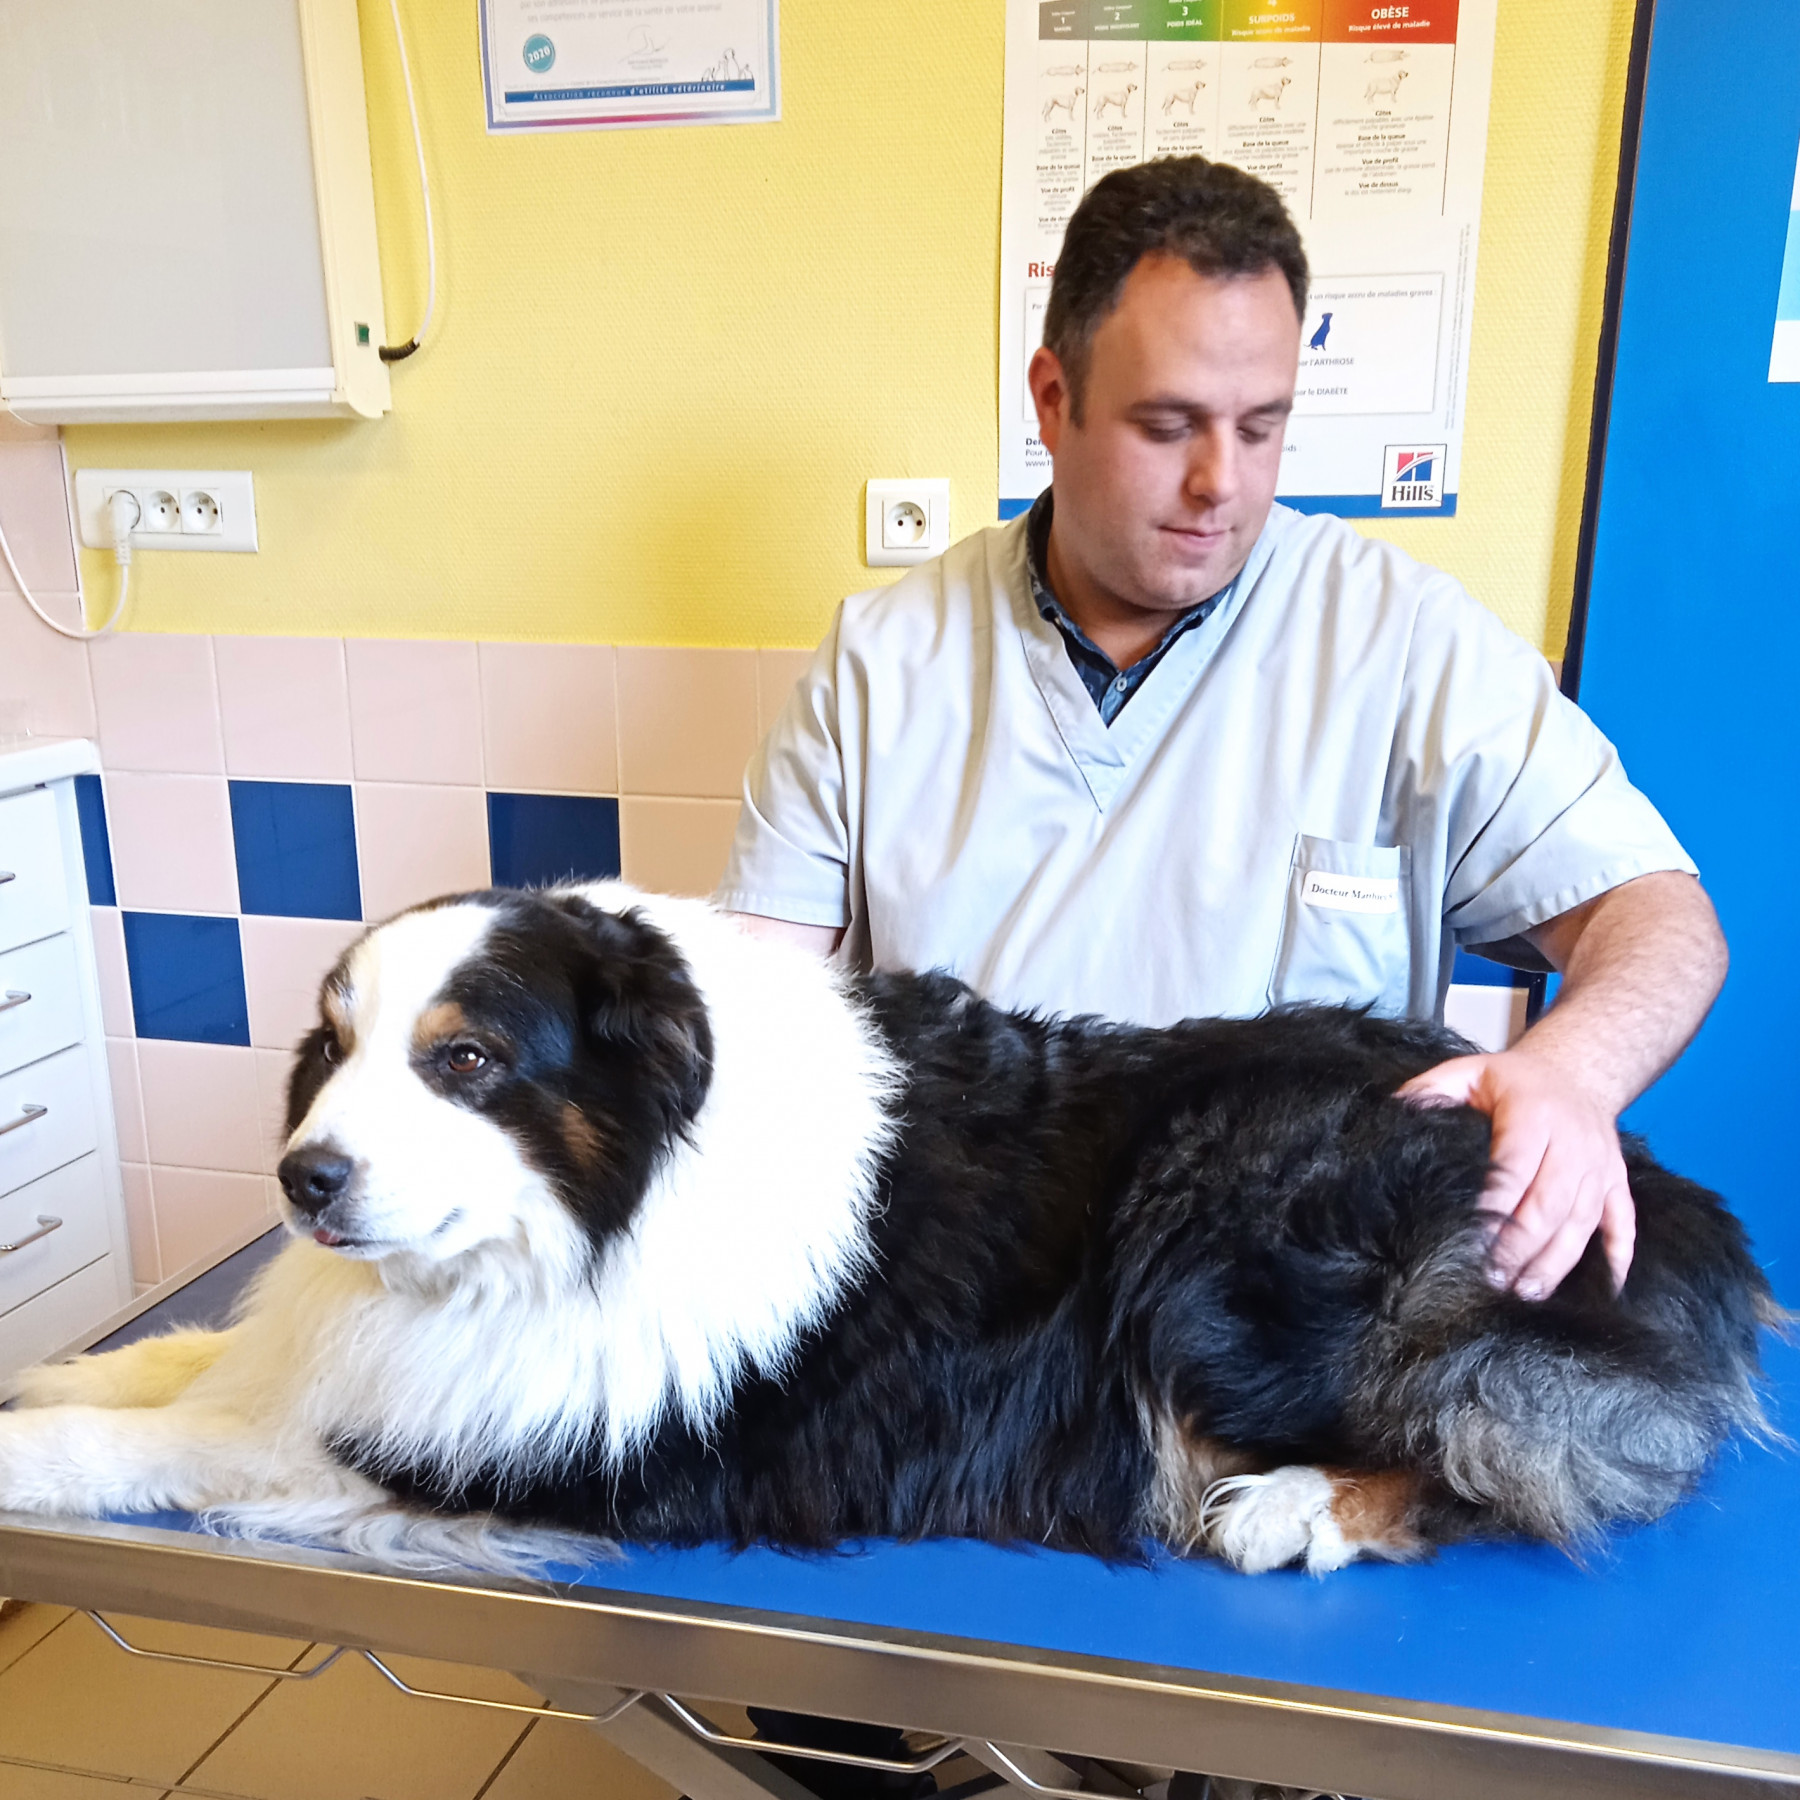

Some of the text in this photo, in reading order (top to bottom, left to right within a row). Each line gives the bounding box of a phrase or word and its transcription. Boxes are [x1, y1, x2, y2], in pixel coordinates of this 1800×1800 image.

[1114, 12, 1120, 20] 2
[1181, 6, 1189, 16] 3
[1371, 5, 1410, 20] OBÈSE
[1060, 16, 1066, 24] 1
[1185, 18, 1203, 27] IDÉAL
[1249, 13, 1295, 25] SURPOIDS
[1348, 19, 1431, 33] Risque élevé de maladie
[527, 45, 552, 63] 2020
[533, 90, 584, 101] Association
[587, 89, 626, 98] reconnue
[630, 84, 669, 96] d'utilité
[673, 81, 726, 93] vétérinaire
[1387, 133, 1406, 141] queue
[1382, 156, 1399, 165] profil
[1379, 180, 1399, 188] dessus
[1028, 261, 1056, 278] Ris
[1324, 292, 1346, 301] risque
[1366, 290, 1376, 298] de
[1377, 289, 1408, 297] maladies
[1409, 289, 1433, 299] graves
[1309, 357, 1354, 366] l'ARTHROSE
[1308, 388, 1315, 396] le
[1316, 387, 1349, 396] DIABÈTE
[1025, 449, 1043, 457] Pour
[1391, 485, 1434, 501] Hill's
[1311, 883, 1349, 897] Docteur
